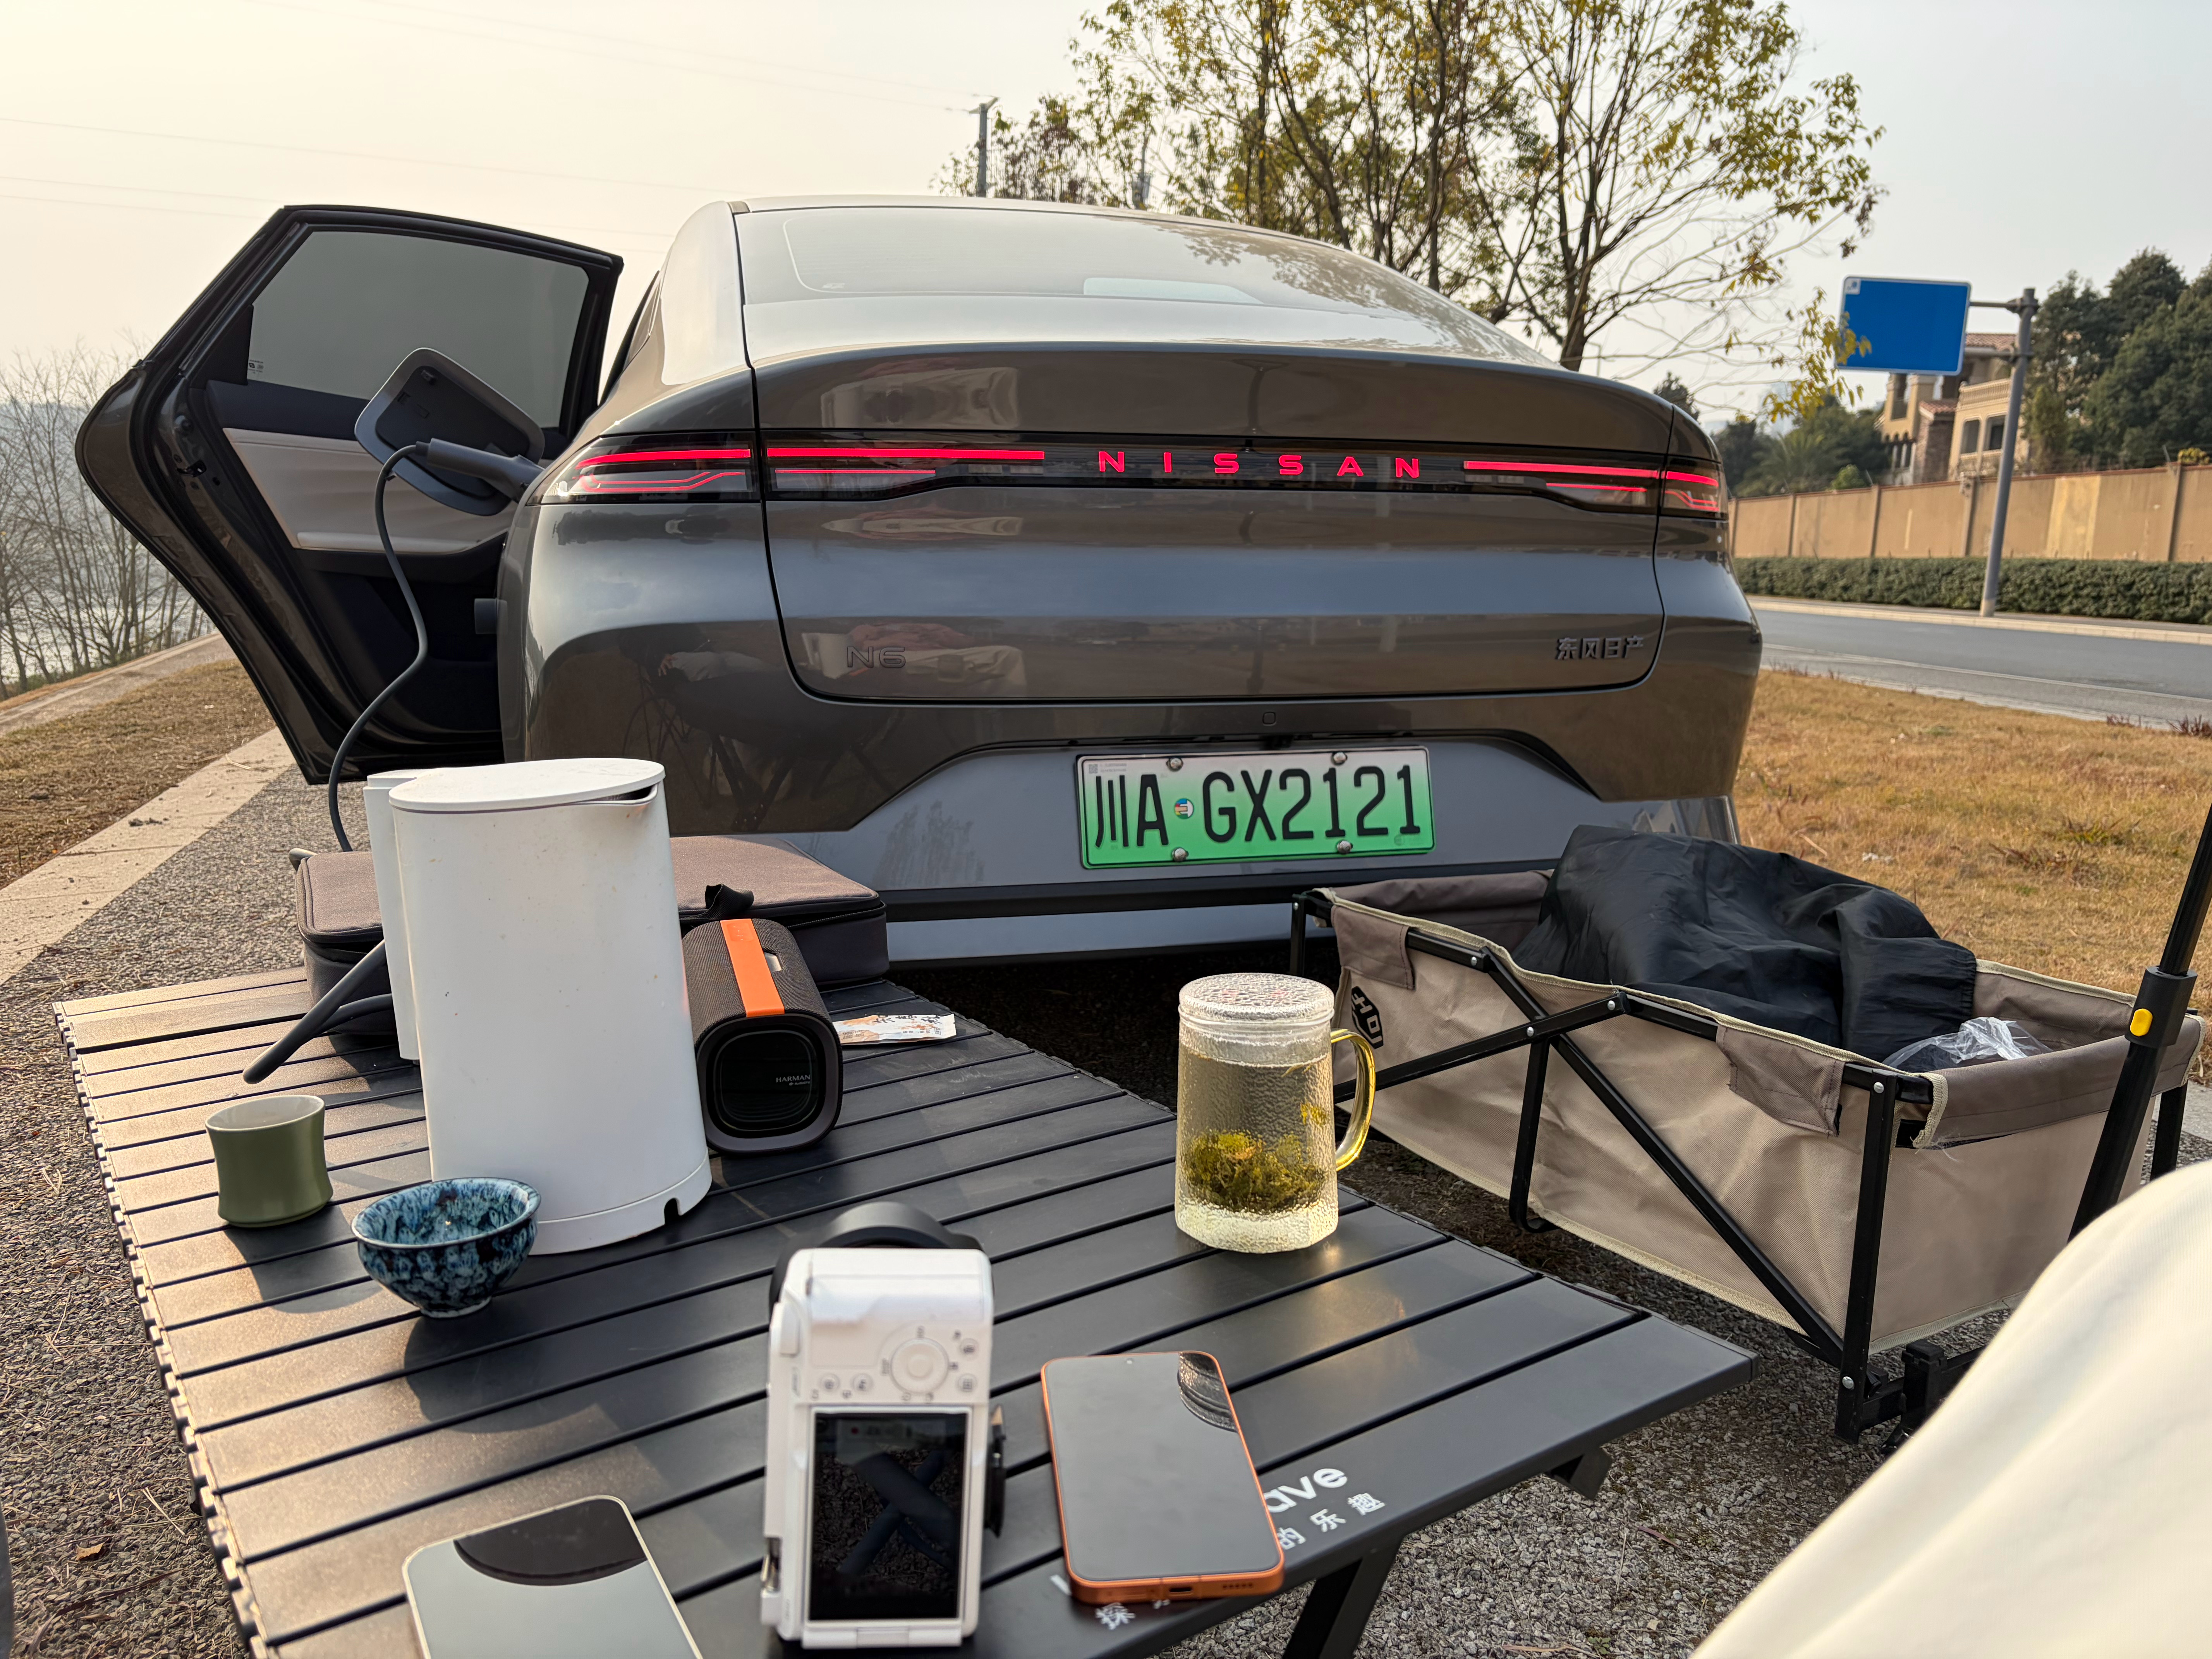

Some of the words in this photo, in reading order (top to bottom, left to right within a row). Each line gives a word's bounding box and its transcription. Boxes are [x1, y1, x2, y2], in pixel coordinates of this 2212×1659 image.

[1099, 451, 1419, 478] NISSAN
[847, 646, 906, 668] N6
[1556, 635, 1644, 659] 东风日产
[776, 1075, 811, 1083] HARMAN
[1264, 1468, 1348, 1513] ave
